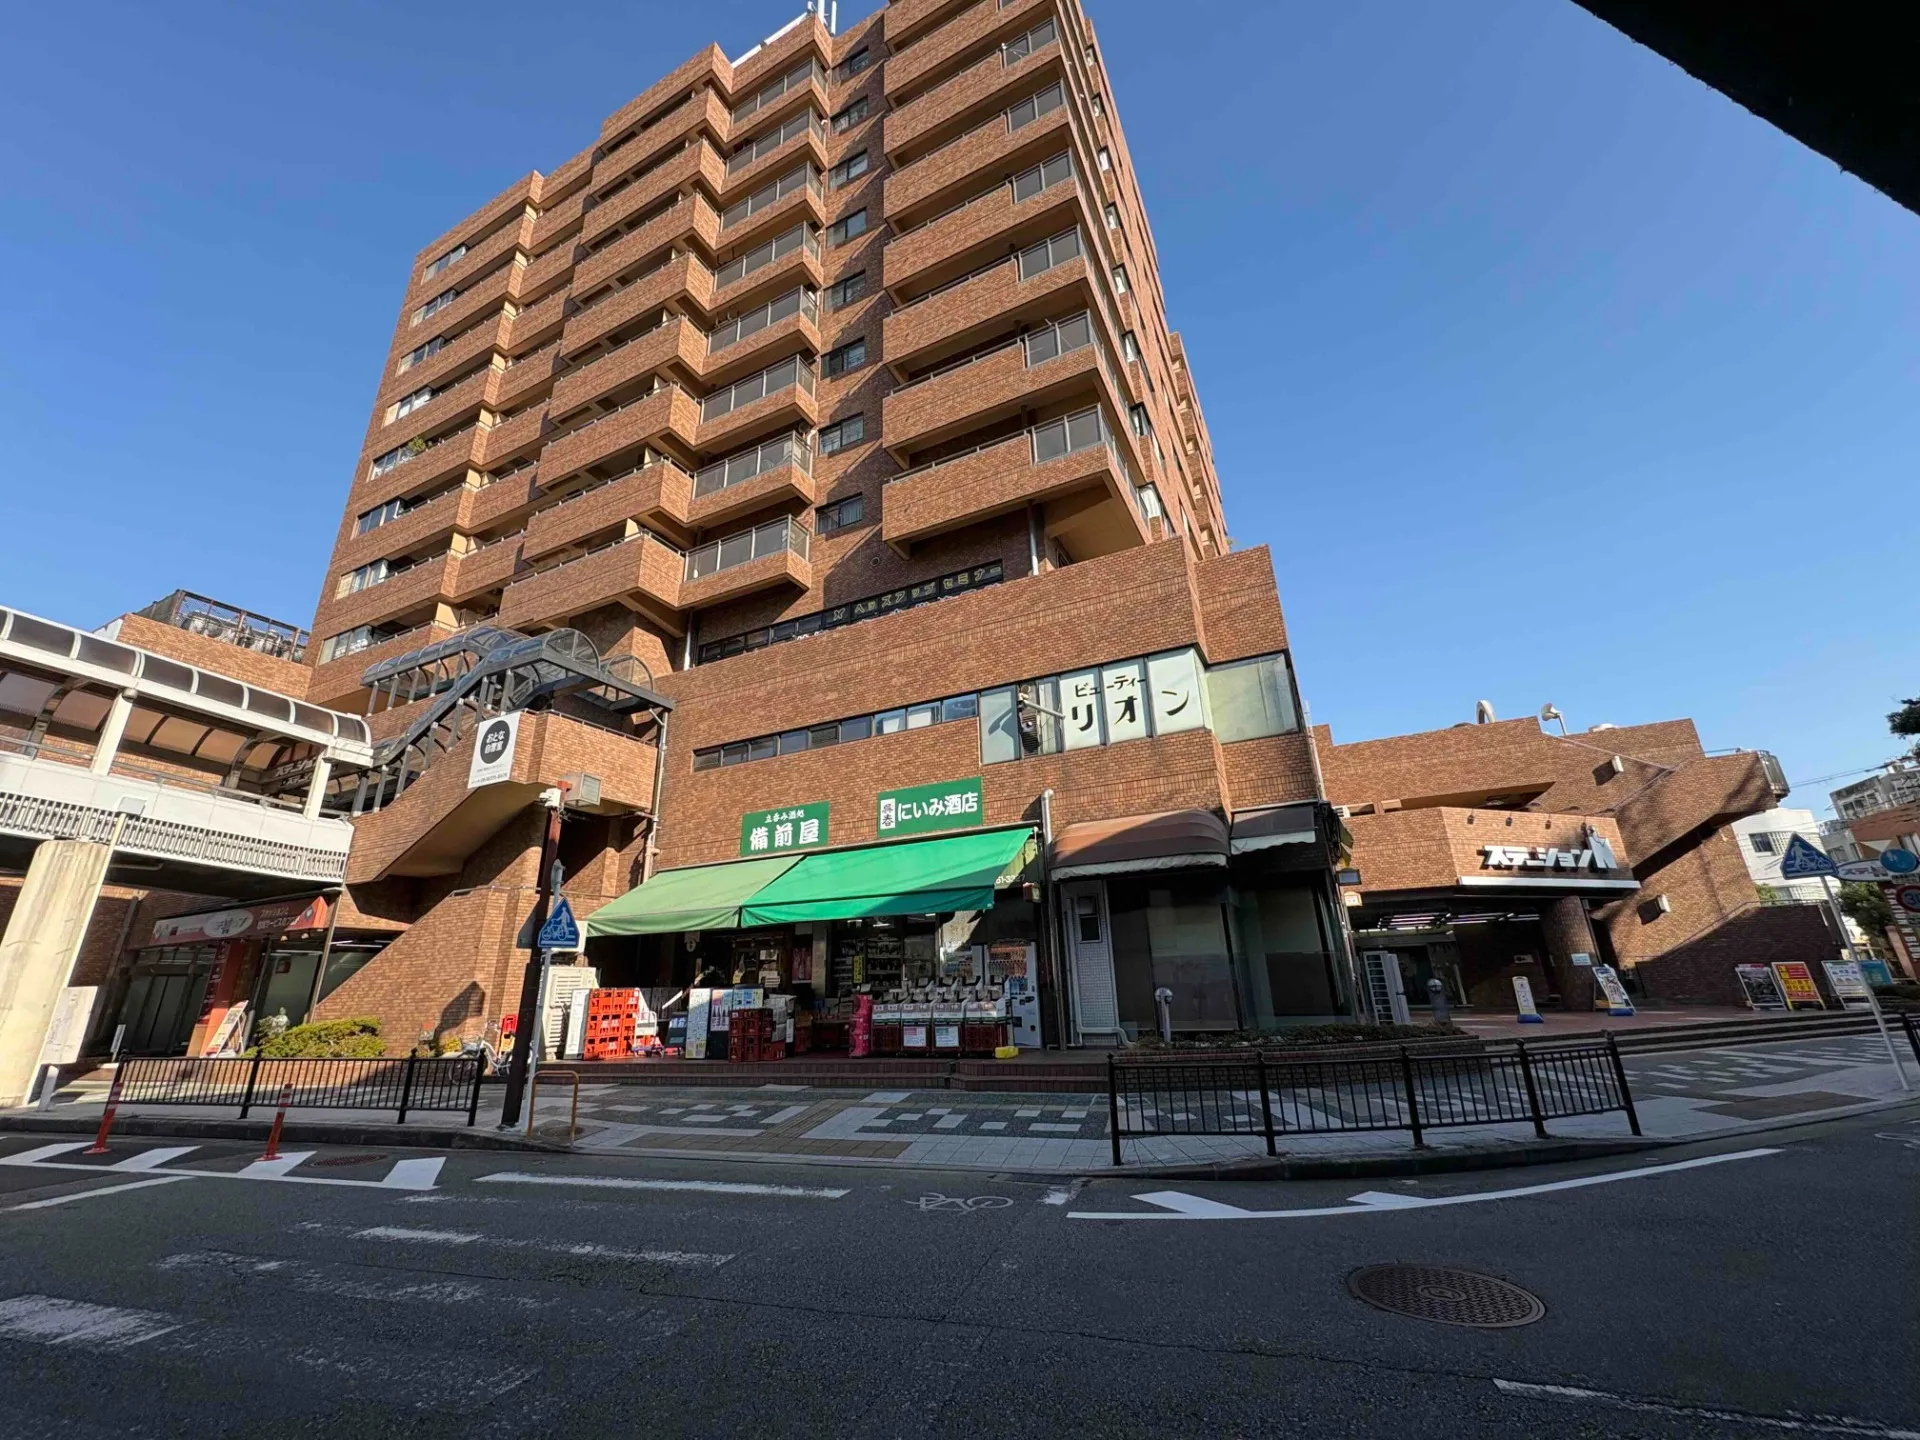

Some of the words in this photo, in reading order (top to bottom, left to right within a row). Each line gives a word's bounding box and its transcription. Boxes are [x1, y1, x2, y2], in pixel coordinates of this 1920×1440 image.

[1074, 674, 1146, 698] ビューティー
[1071, 690, 1190, 732] リオン
[486, 730, 506, 744] おとな
[897, 791, 979, 822] にいみ酒店
[749, 819, 819, 851] 備前屋
